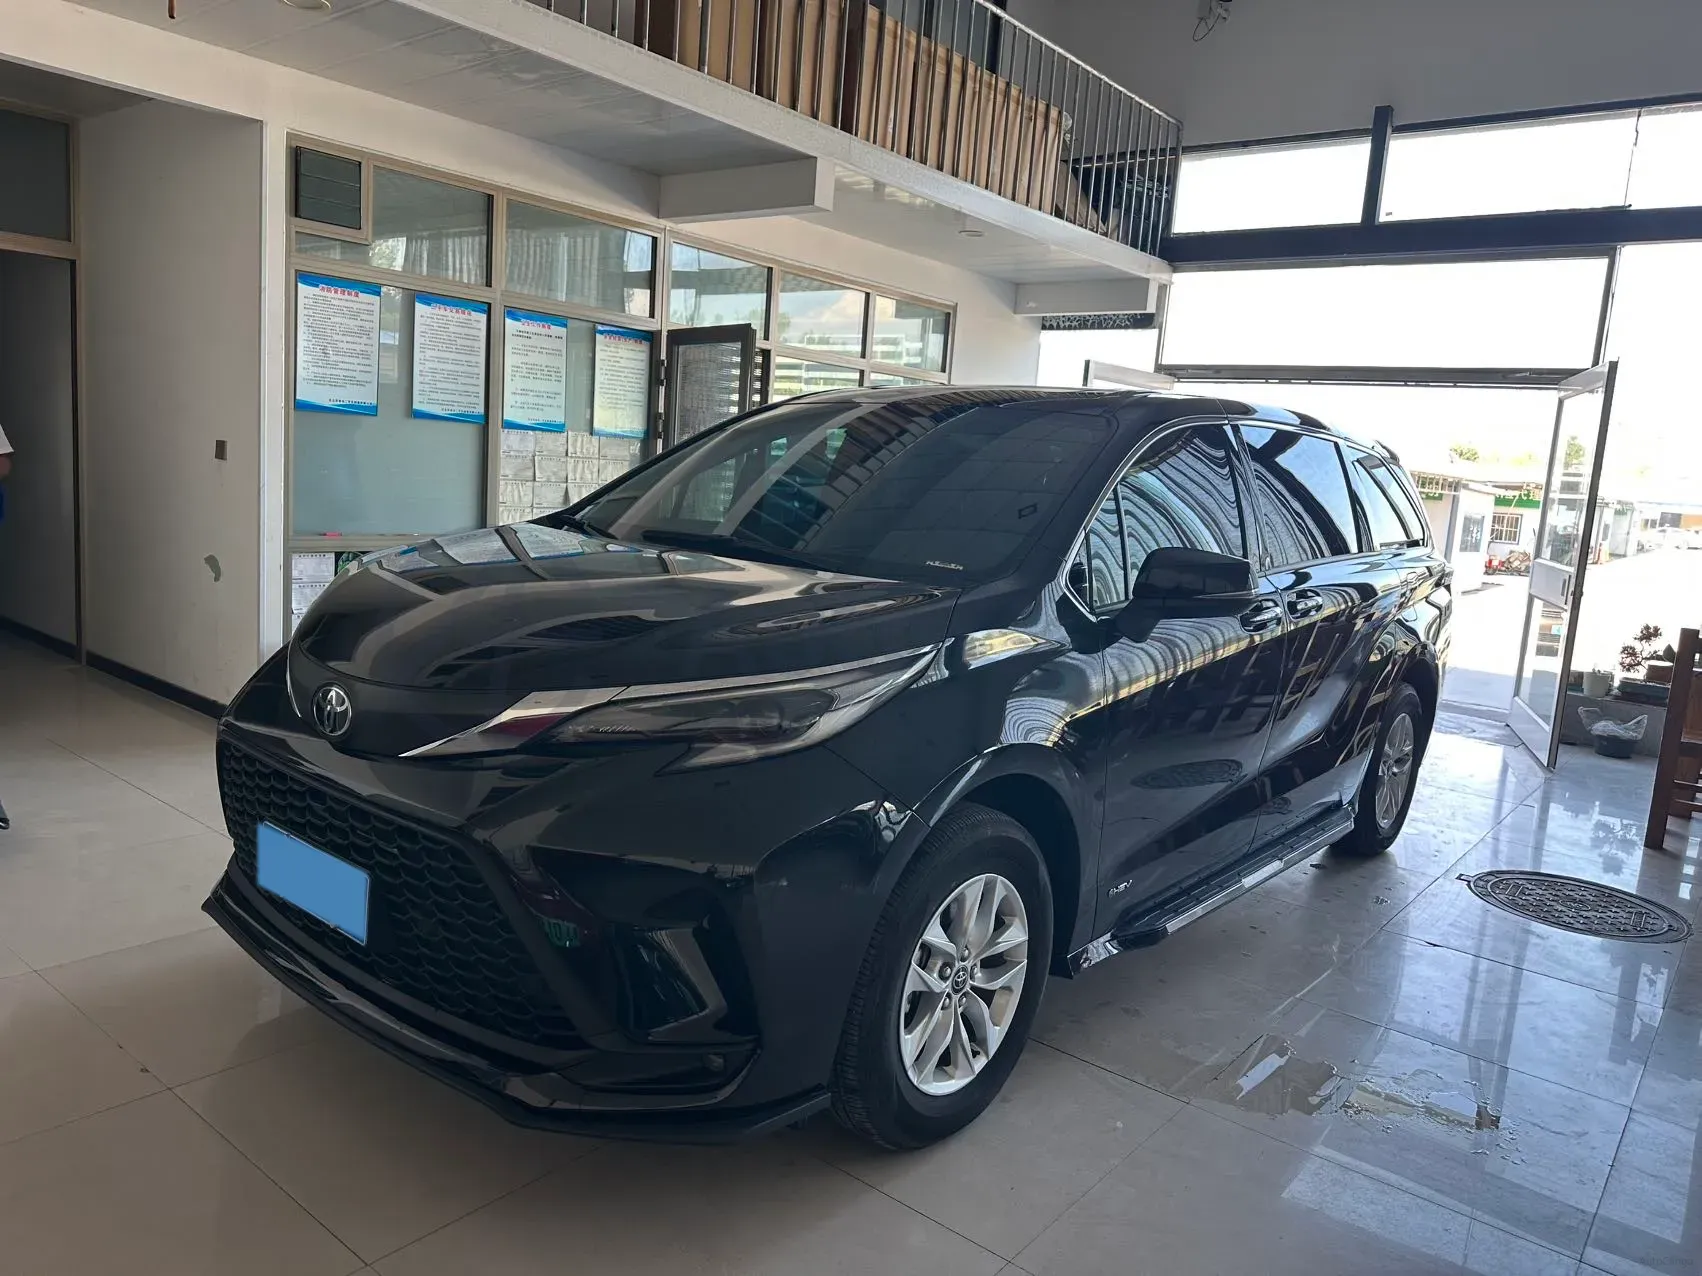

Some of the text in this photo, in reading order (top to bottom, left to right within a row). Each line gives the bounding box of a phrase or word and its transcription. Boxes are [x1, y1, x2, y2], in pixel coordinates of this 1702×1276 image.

[319, 285, 360, 298] 消防管理制度
